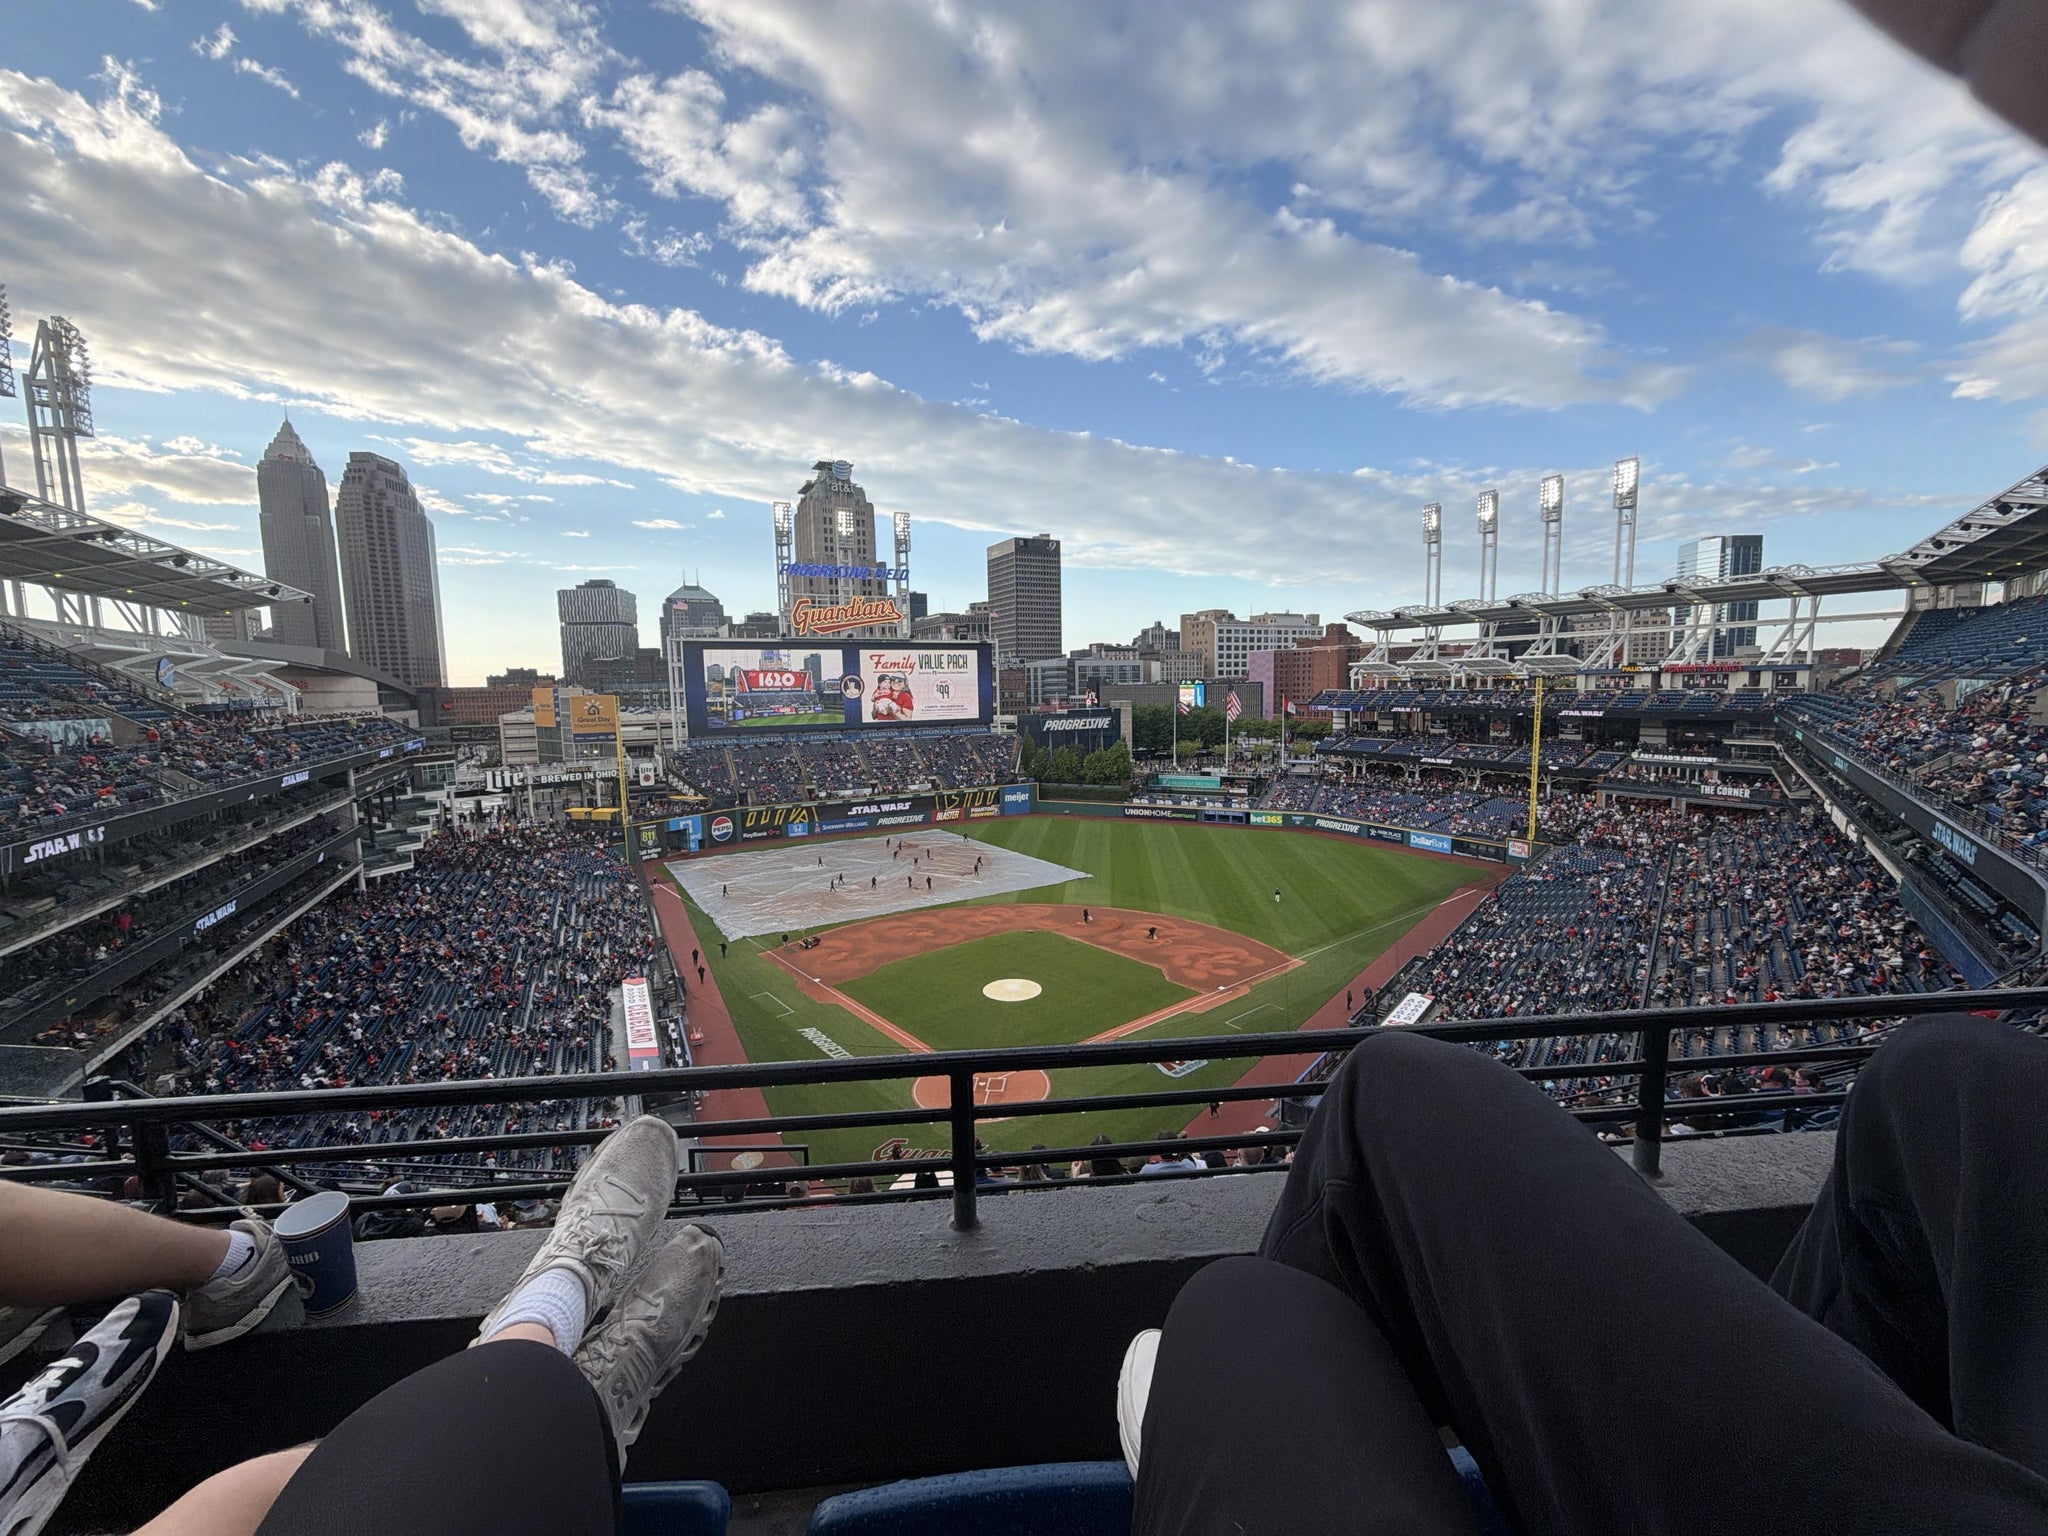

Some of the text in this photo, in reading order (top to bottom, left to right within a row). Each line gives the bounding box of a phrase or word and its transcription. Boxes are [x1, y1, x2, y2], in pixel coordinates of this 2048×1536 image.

[780, 563, 909, 580] PROGRESSIVE FIELD
[792, 596, 904, 635] Guardians
[869, 654, 968, 675] Family VALUE PACK
[758, 672, 795, 687] 1620
[1042, 717, 1112, 732] PROGRESSIVE
[1682, 755, 1718, 763] BREWERY
[541, 770, 617, 784] BREWED IN OHIO
[640, 766, 654, 774] Lite
[485, 771, 524, 793] Lite
[1005, 792, 1029, 804] meijer
[1701, 785, 1716, 795] THE
[1716, 787, 1750, 799] CORNER
[848, 802, 912, 815] STAR WARS
[936, 810, 960, 821] BLASTER
[877, 814, 925, 826] PROGRESSIVE
[1250, 814, 1282, 824] bet365
[713, 825, 732, 833] PEPSI
[1315, 819, 1360, 834] PROGRESSIVE
[642, 830, 656, 842] 811
[24, 826, 105, 864] STAR WRS
[1510, 843, 1525, 852] drug
[1931, 821, 1978, 866] STAR WARS
[215, 900, 237, 920] WARS
